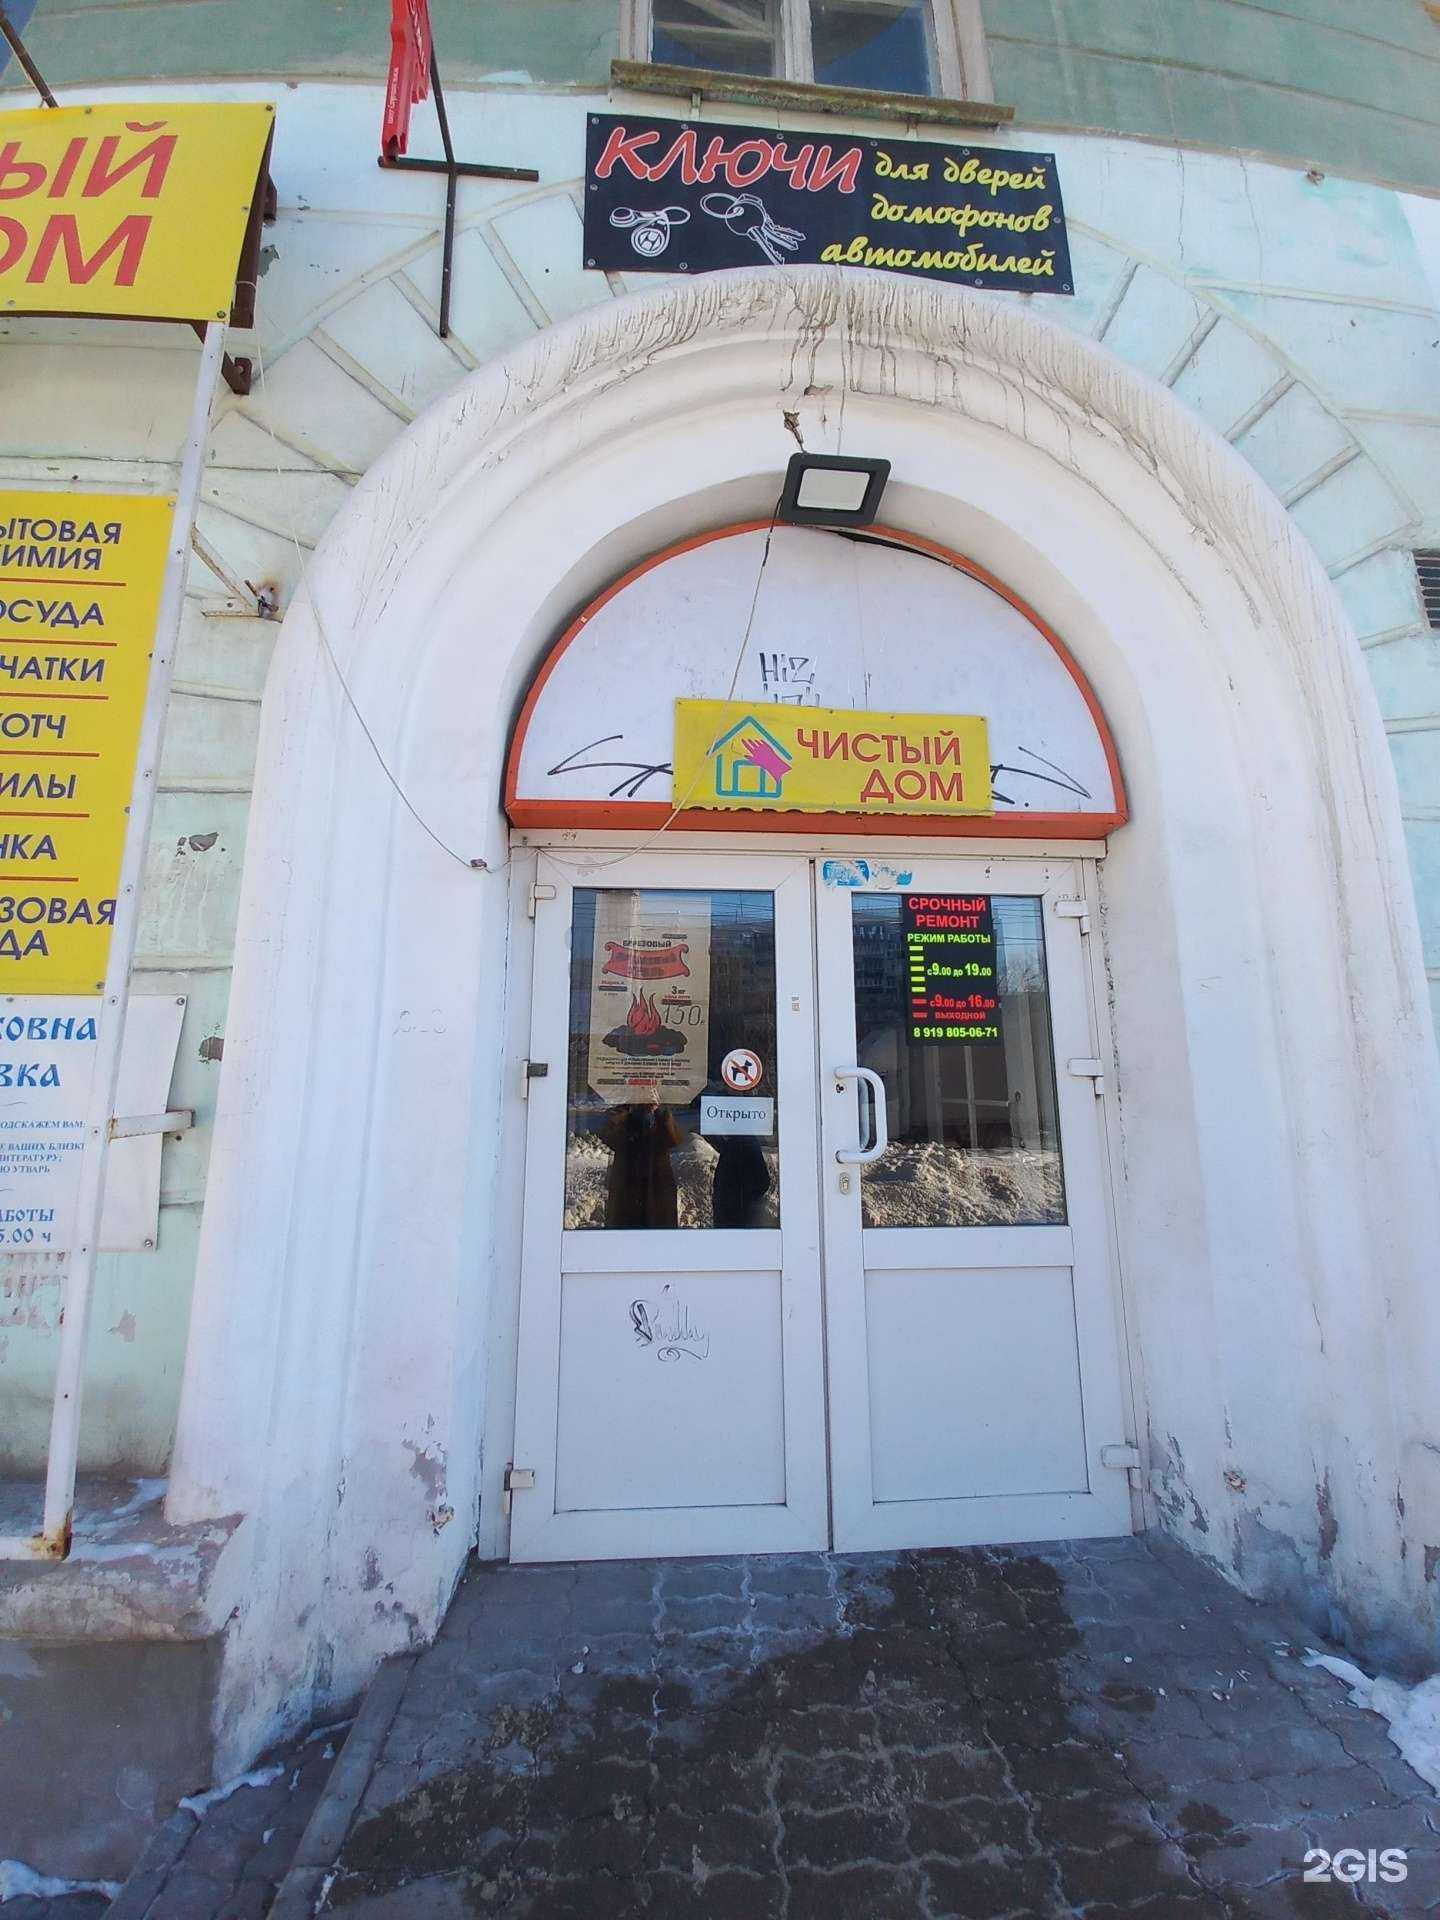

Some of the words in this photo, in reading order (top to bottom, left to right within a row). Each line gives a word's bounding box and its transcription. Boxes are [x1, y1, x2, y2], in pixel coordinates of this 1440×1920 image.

[595, 126, 863, 194] КЛЮЧИ
[875, 151, 930, 181] для
[943, 157, 1047, 197] дверей
[870, 192, 1053, 237] домофонов
[819, 236, 1056, 276] автомобилей
[0, 544, 103, 571] ИМИЯ
[0, 599, 105, 629] СУДА
[0, 712, 67, 739] ОТЧ
[797, 728, 961, 766] ЧИСТЫЙ
[860, 769, 963, 804] ДОМ
[908, 897, 986, 912] СРОЧНЫЙ
[916, 915, 980, 928] РЕМОНТ
[907, 934, 945, 943] РЕЖИМ
[947, 934, 991, 944] РАБОТЫ
[953, 969, 963, 977] до
[965, 963, 992, 976] 19.00
[0, 1016, 97, 1041] ОВНА
[914, 1028, 920, 1038] 8
[923, 1028, 944, 1038] 919
[946, 1028, 998, 1038] 805-06-71
[706, 1106, 767, 1121] Открыто
